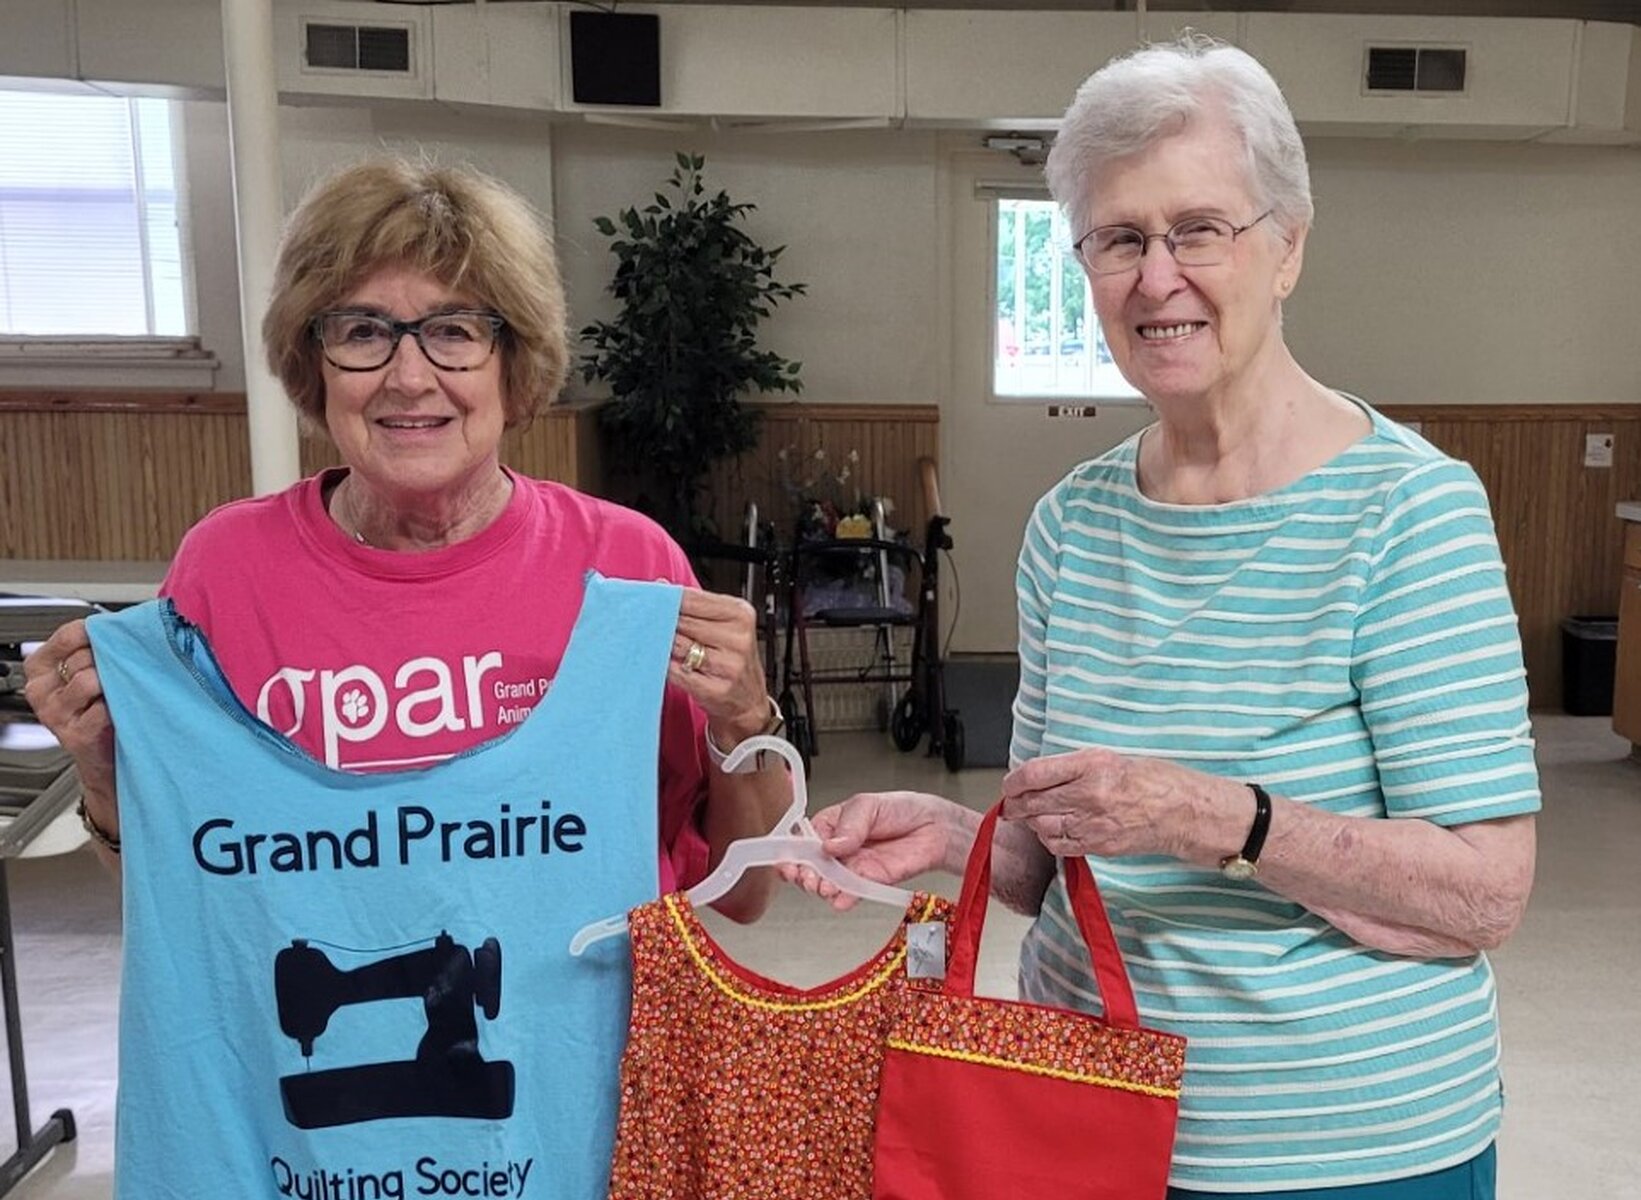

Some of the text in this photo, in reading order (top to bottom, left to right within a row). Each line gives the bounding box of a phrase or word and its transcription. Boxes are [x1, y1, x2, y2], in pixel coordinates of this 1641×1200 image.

[1059, 405, 1086, 417] EXIT
[494, 678, 553, 700] Grand P
[192, 801, 587, 875] Grand Prairie
[415, 1156, 533, 1199] Society
